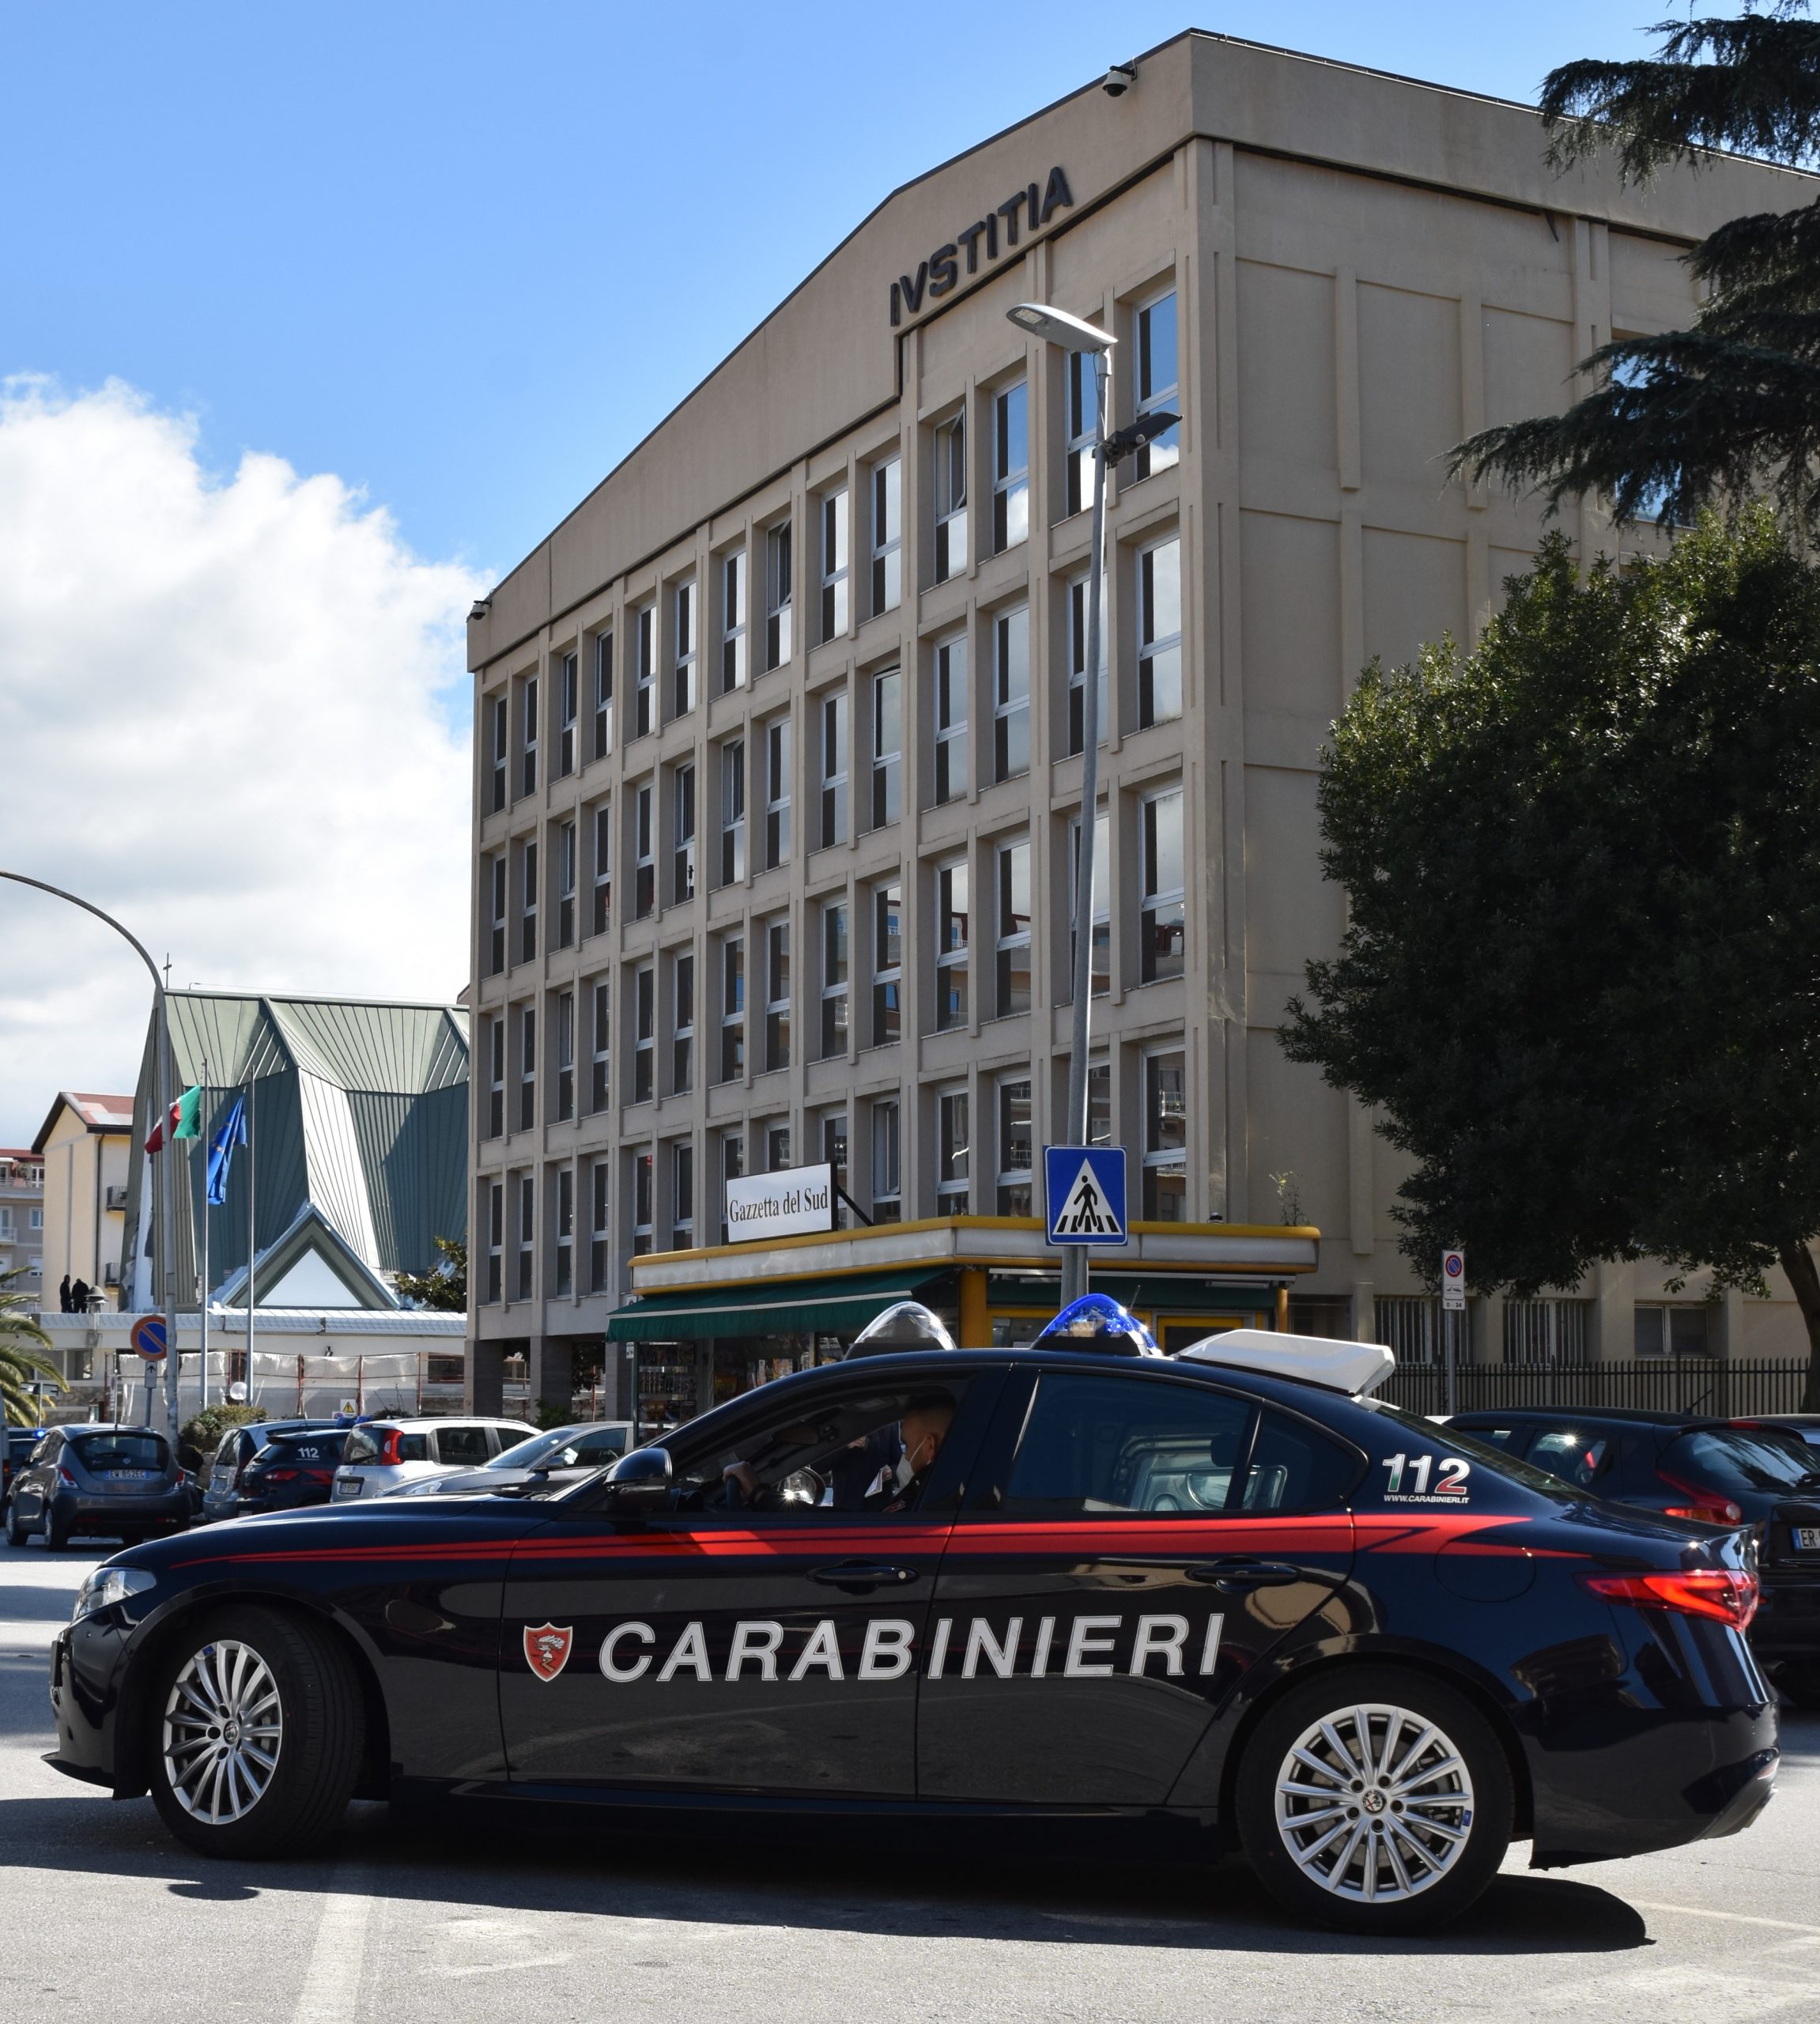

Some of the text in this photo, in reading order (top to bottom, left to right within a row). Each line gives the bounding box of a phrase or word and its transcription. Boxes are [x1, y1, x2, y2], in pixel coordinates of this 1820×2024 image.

[890, 167, 1074, 327] IVSTITIA
[730, 1185, 828, 1222] Gazzetta del Sud
[297, 1447, 319, 1458] 112
[1382, 1453, 1470, 1495] 112
[1384, 1494, 1470, 1504] WWW.CARABINIERI.IT
[1801, 1530, 1817, 1546] ER
[599, 1613, 1225, 1682] CARABINIERI
